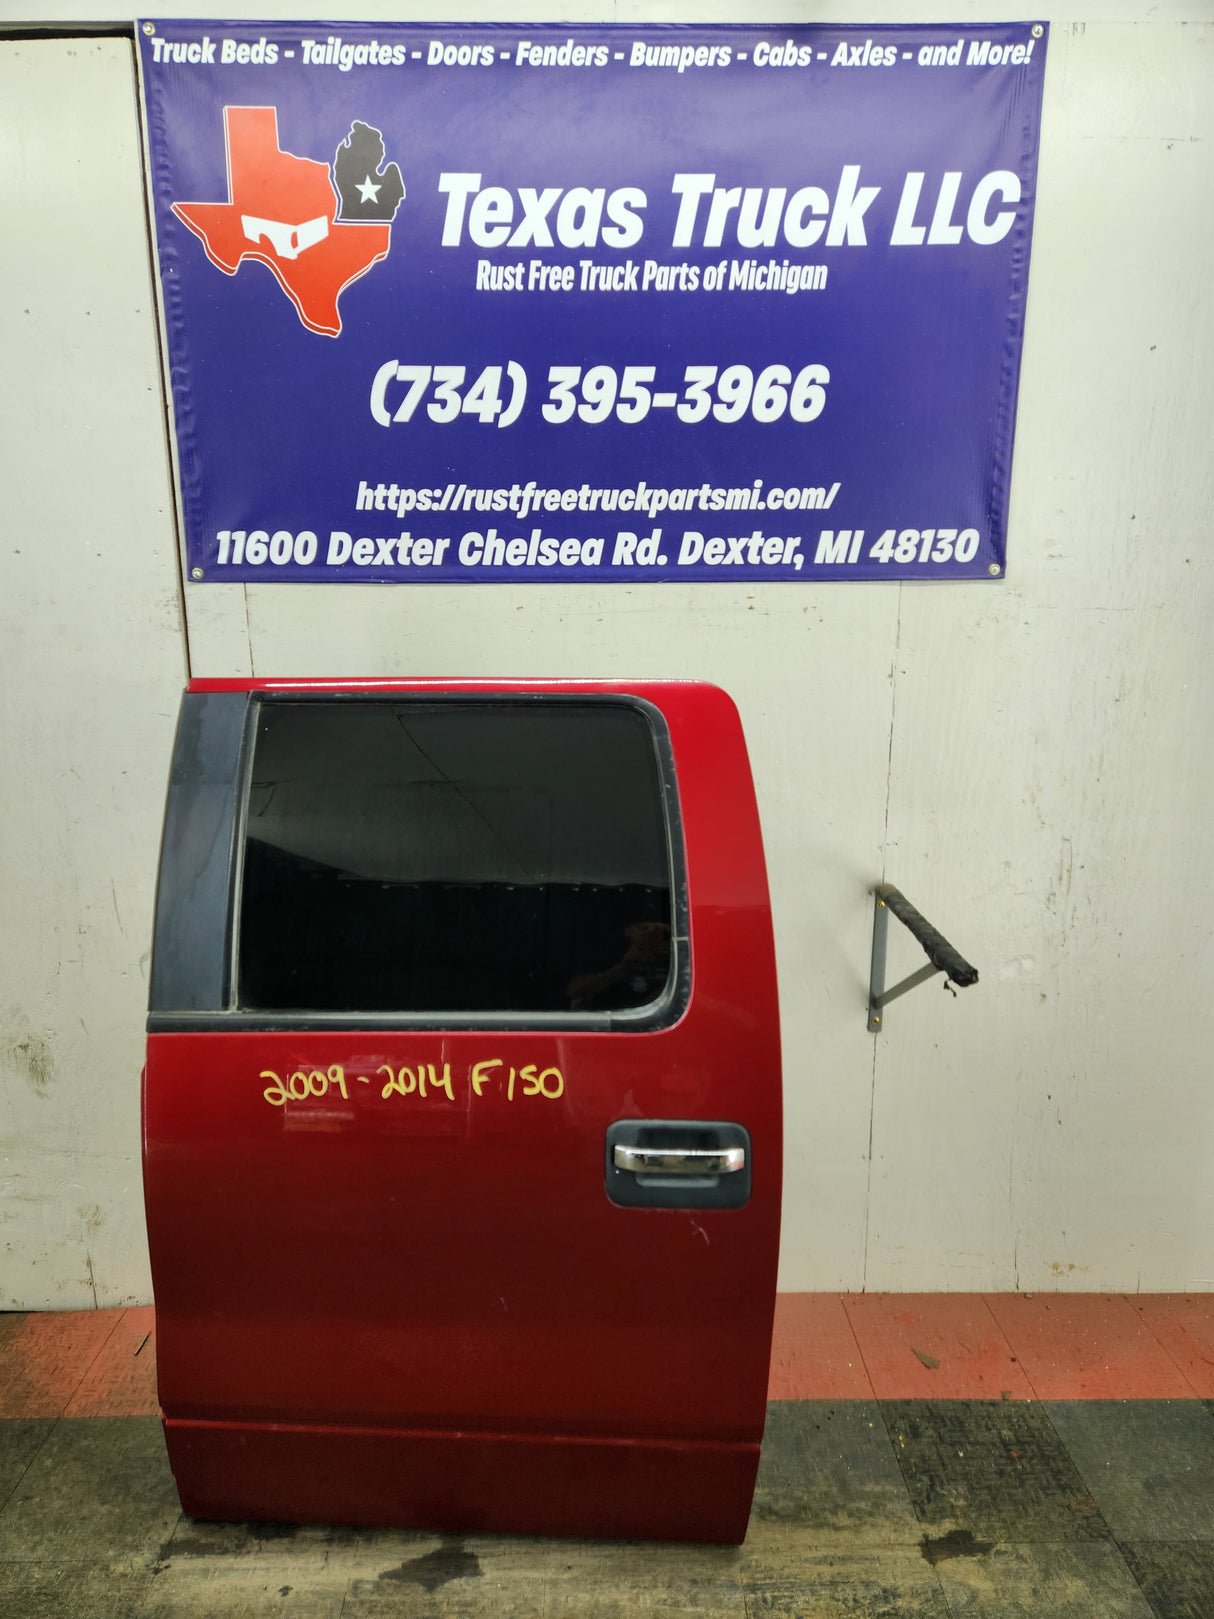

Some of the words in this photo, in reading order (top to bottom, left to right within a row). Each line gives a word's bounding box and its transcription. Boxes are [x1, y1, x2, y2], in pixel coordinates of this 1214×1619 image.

[151, 37, 216, 63] Truck
[221, 37, 279, 64] Beds
[301, 36, 406, 71] Tailgates
[427, 40, 495, 66] Doors
[516, 39, 609, 66] Fenders
[630, 41, 732, 73] Bumpers
[753, 40, 812, 66] Cabs
[831, 39, 897, 66] Axles
[918, 39, 964, 66] and
[966, 40, 1035, 65] More!
[438, 173, 647, 248] Texas
[672, 164, 882, 248] Truck
[890, 170, 1021, 246] LLC
[476, 260, 525, 291] Rust
[528, 260, 574, 291] Free
[580, 260, 640, 291] Truck
[642, 260, 700, 291] Parts
[703, 260, 727, 290] of
[729, 260, 828, 294] Michigan
[371, 360, 527, 428] (734)
[542, 364, 830, 424] 395-3966
[356, 480, 841, 518] https://rustfreetruckpartsmi.com/
[217, 531, 317, 565] 11600
[327, 532, 450, 565] Dexter
[459, 529, 604, 566] Chelsea
[612, 529, 667, 566] Rd.
[678, 531, 804, 570] Dexter,
[814, 530, 864, 563] MI
[869, 529, 979, 563] 48130
[260, 1065, 348, 1106] 2009
[376, 1064, 455, 1100] 2014
